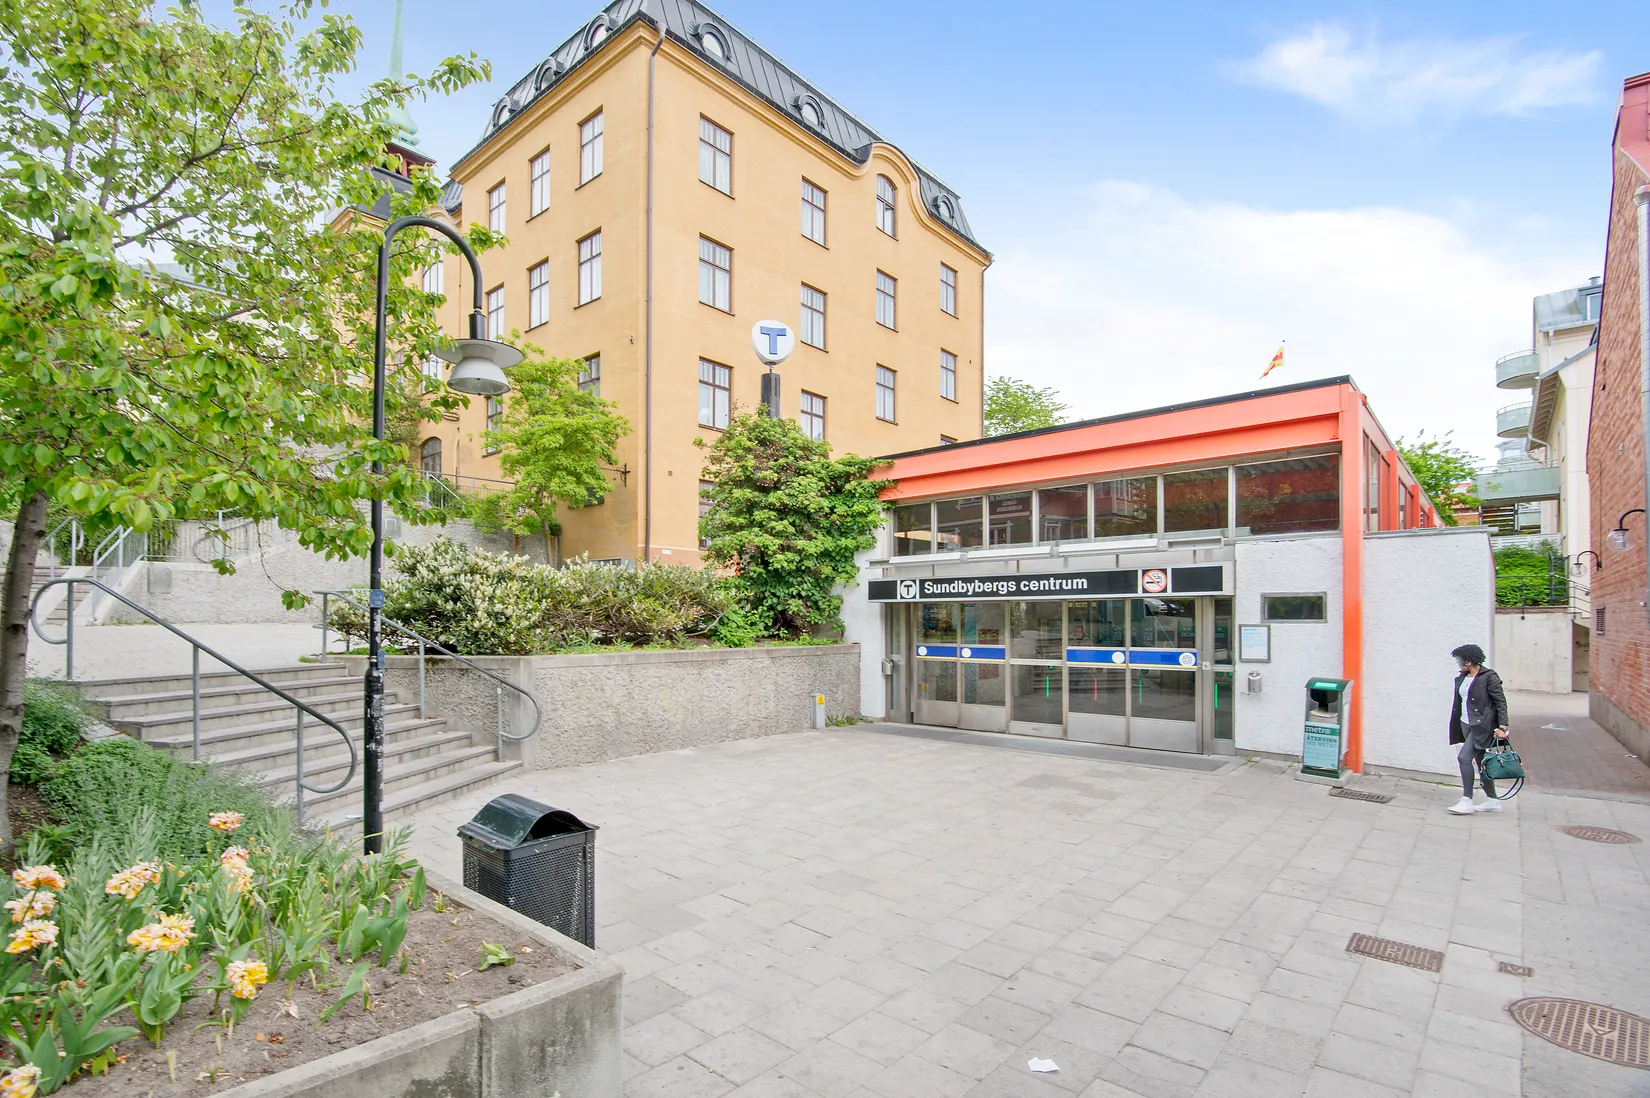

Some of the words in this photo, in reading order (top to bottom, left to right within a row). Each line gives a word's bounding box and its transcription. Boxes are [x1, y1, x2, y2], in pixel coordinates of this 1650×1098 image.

[760, 326, 786, 355] T
[903, 584, 913, 596] T
[924, 579, 1017, 595] Sundbybergs
[1020, 577, 1088, 591] centrum
[1305, 726, 1331, 735] metro
